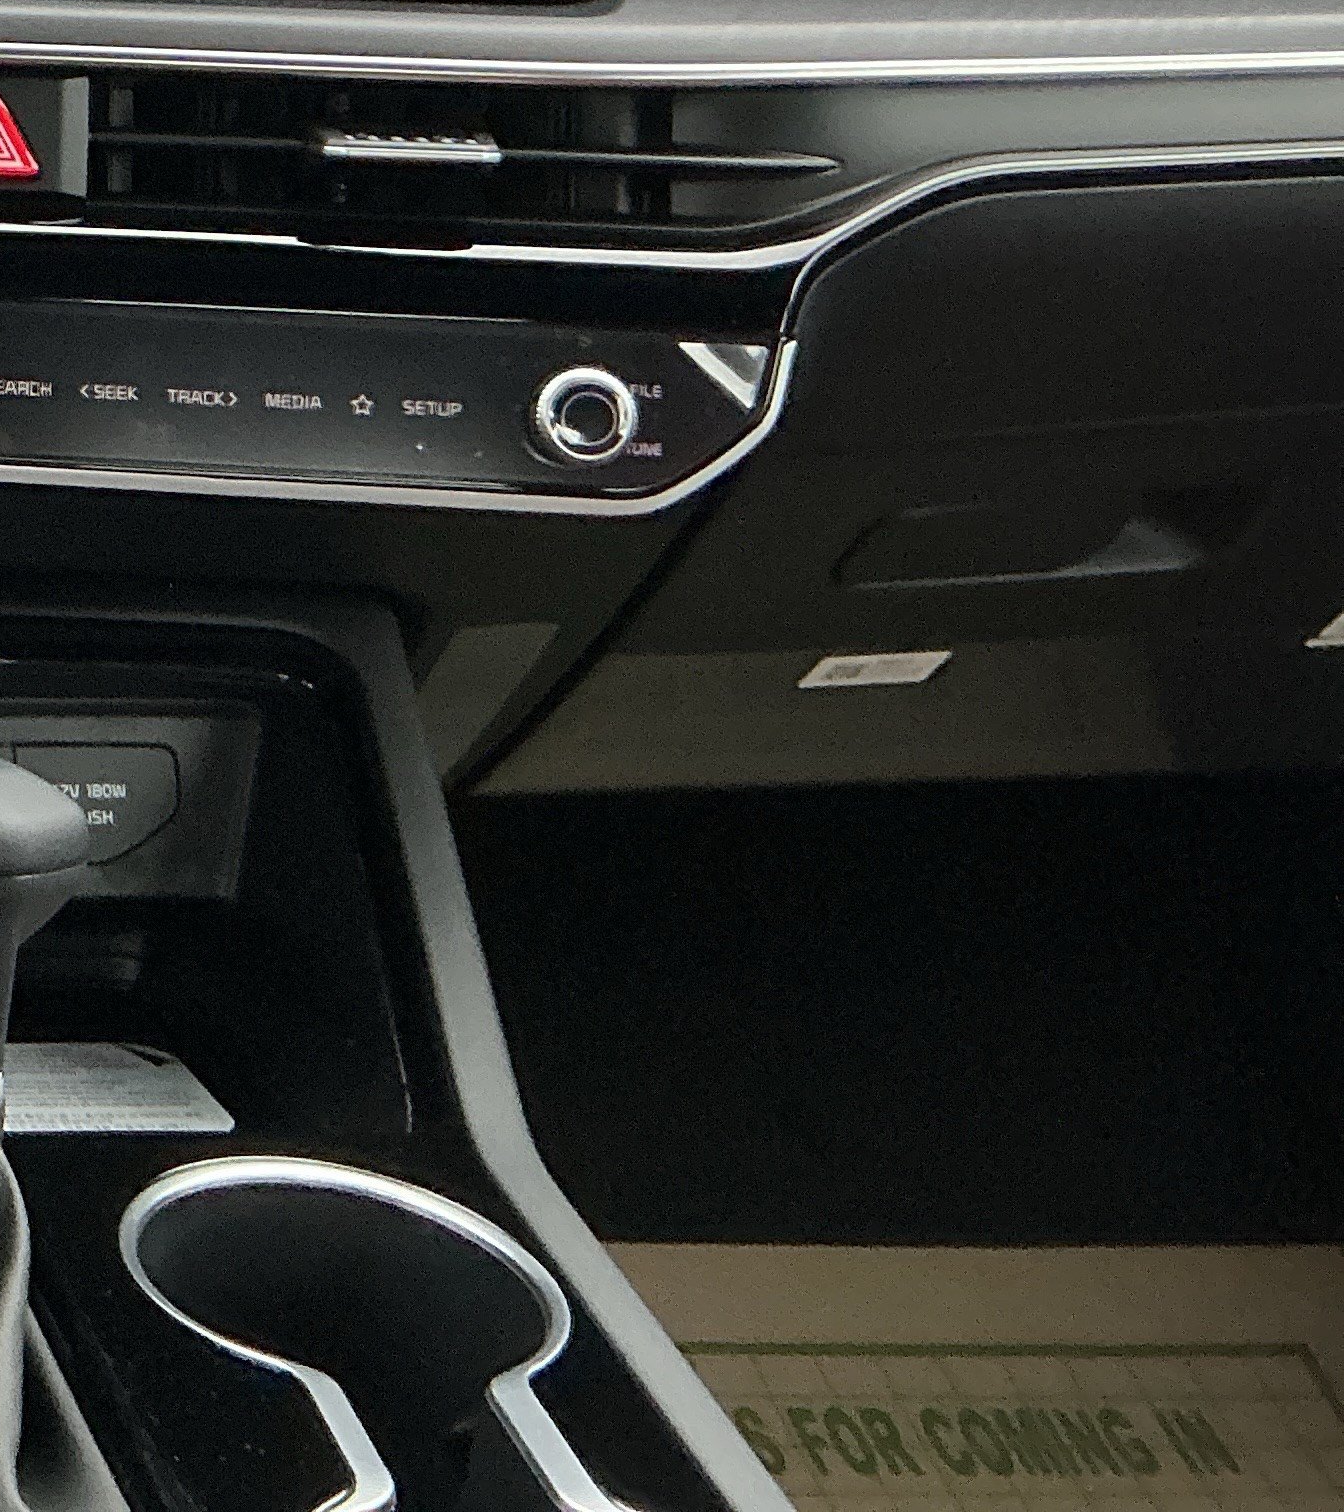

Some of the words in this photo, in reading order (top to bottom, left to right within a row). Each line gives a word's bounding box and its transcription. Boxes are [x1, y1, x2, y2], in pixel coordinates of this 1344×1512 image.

[264, 392, 322, 410] MEDIA
[402, 400, 463, 418] SETUP
[86, 783, 127, 799] 180W
[788, 1406, 924, 1477] FOR
[919, 1406, 1160, 1477] COMING
[1153, 1408, 1241, 1477] IN
